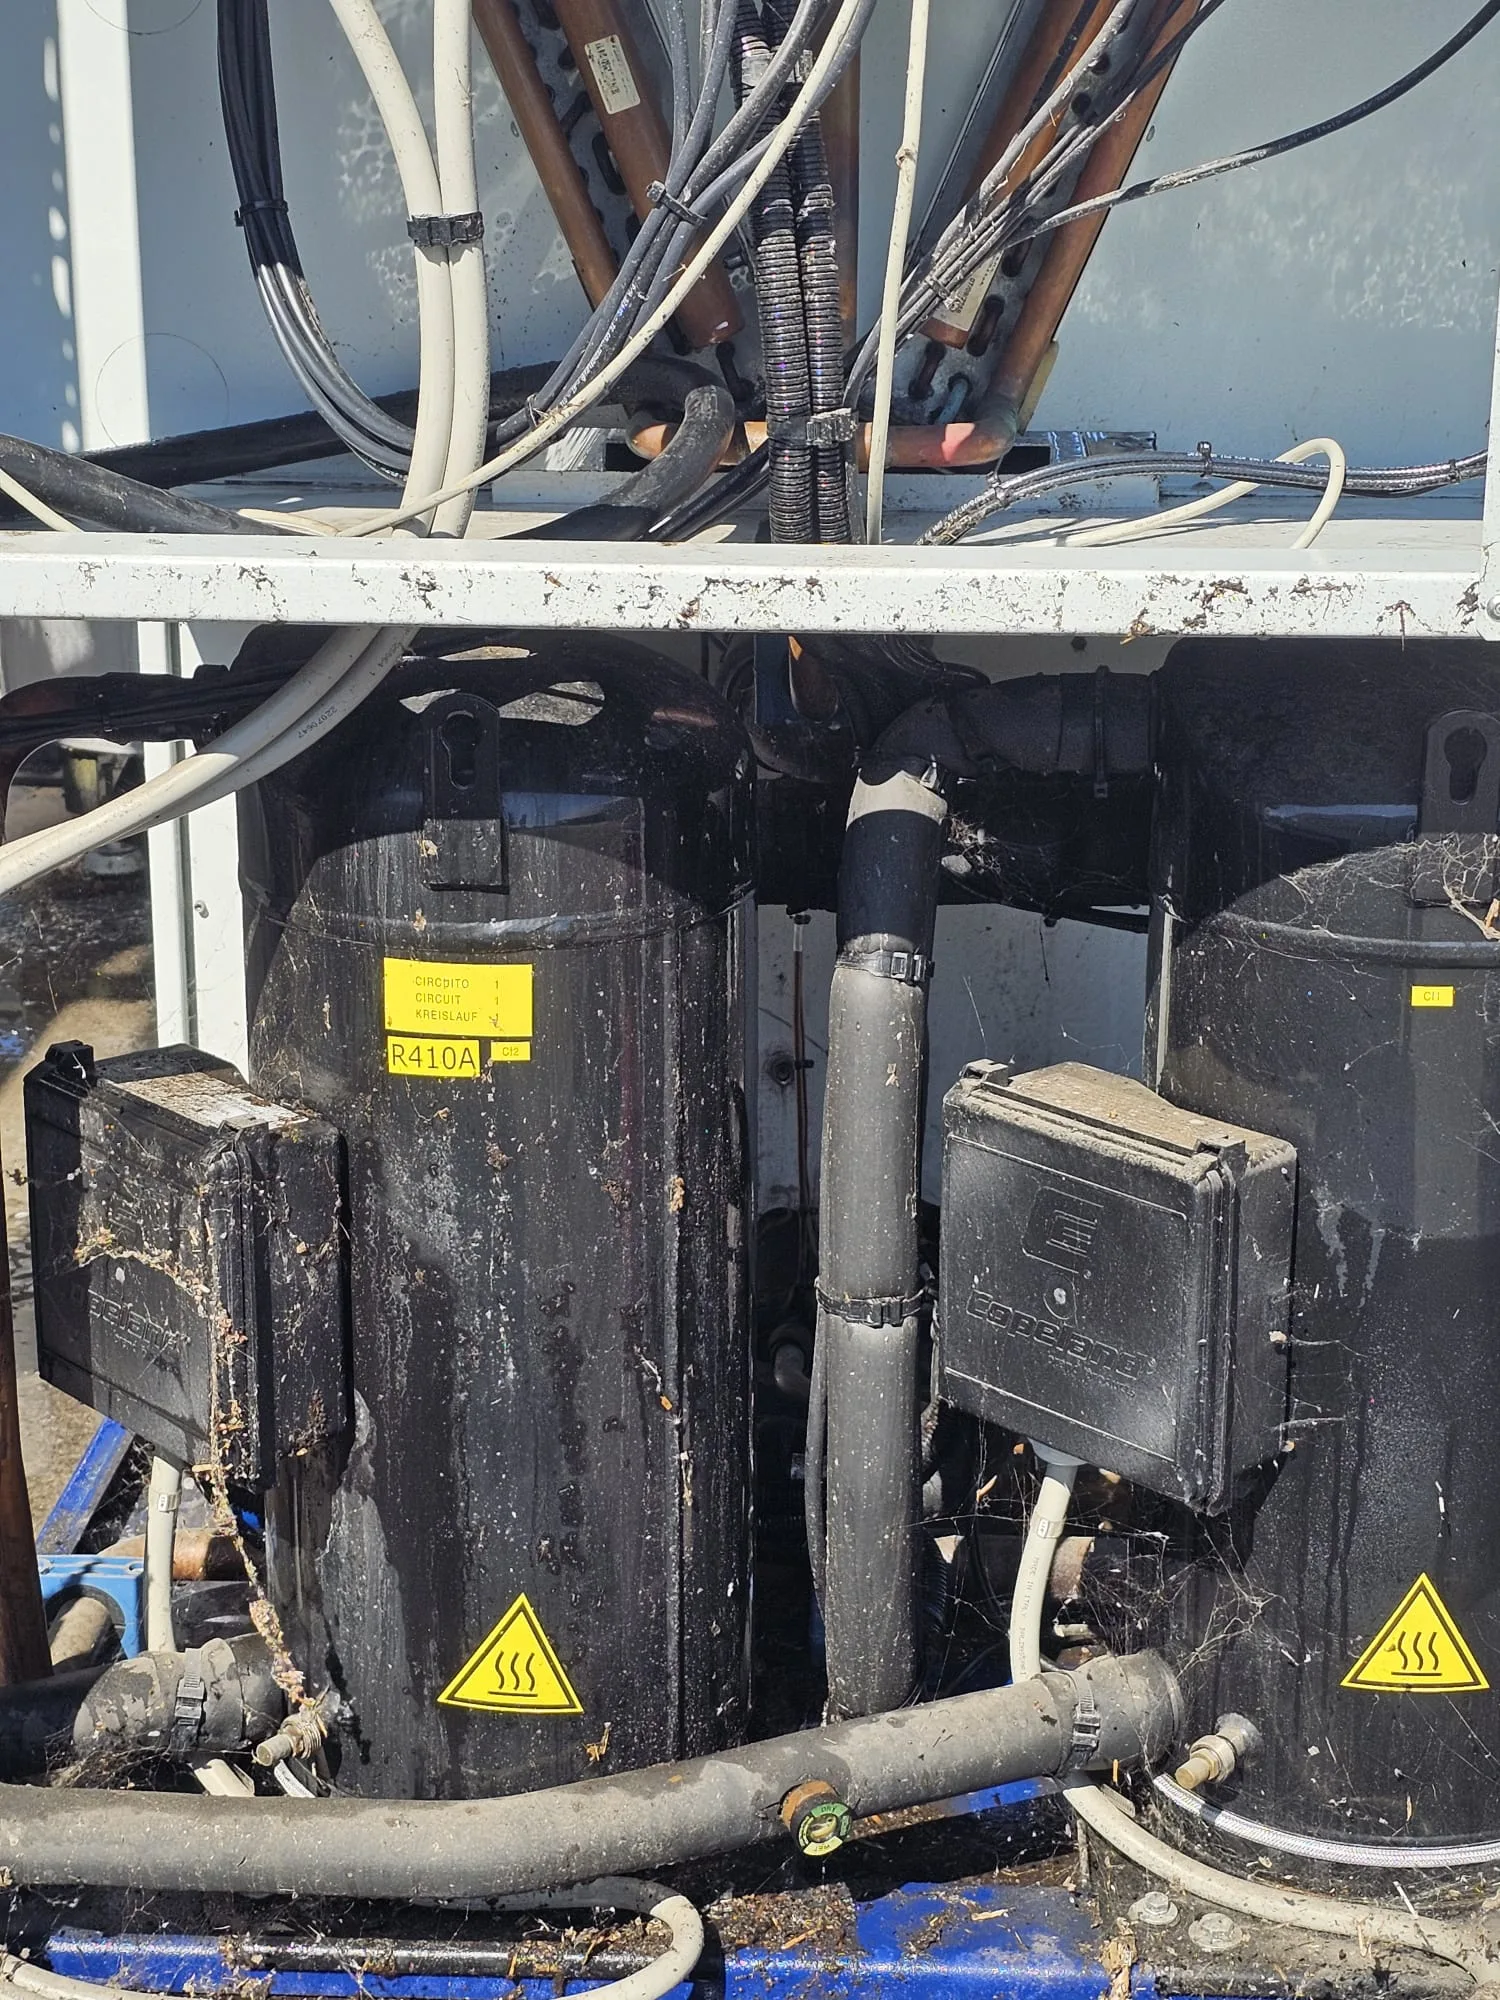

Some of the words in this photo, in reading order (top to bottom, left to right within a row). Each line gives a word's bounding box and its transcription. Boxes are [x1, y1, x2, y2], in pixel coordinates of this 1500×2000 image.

[415, 975, 470, 989] CIRCUITO
[415, 992, 461, 1005] CIRCUIT
[415, 1008, 479, 1022] KREISLAUF
[391, 1044, 476, 1070] R410A
